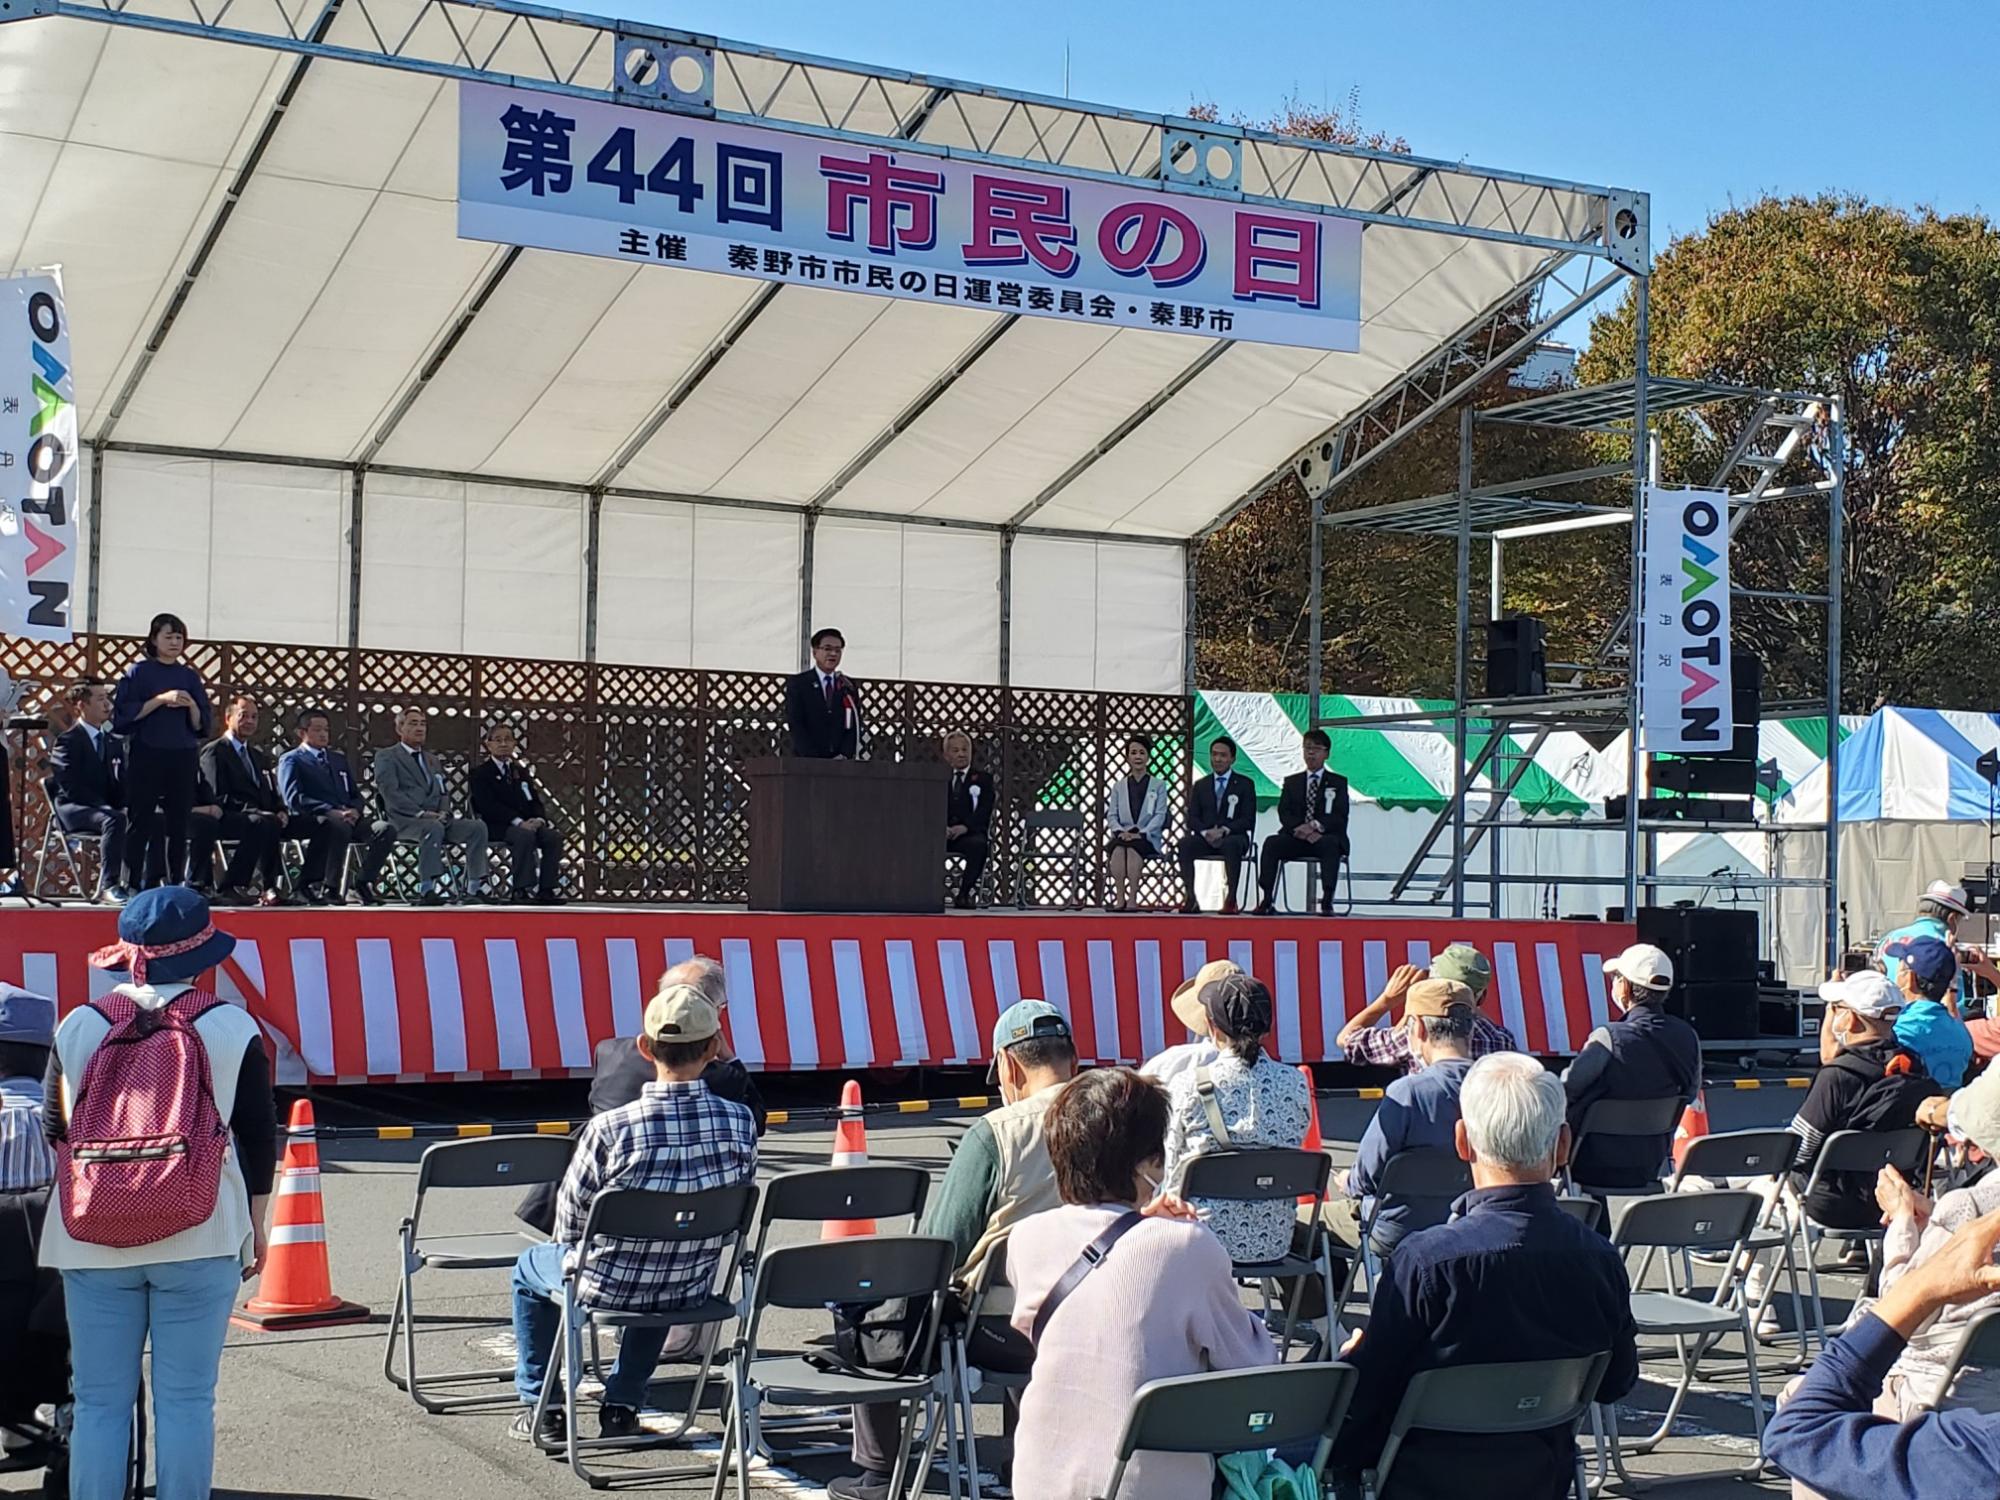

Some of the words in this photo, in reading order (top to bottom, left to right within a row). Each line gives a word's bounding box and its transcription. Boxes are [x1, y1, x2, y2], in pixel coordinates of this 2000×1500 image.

[499, 104, 783, 232] 第44回
[818, 153, 1323, 310] 市民の日
[618, 229, 688, 262] 主催
[1681, 501, 1721, 742] OMOTAN
